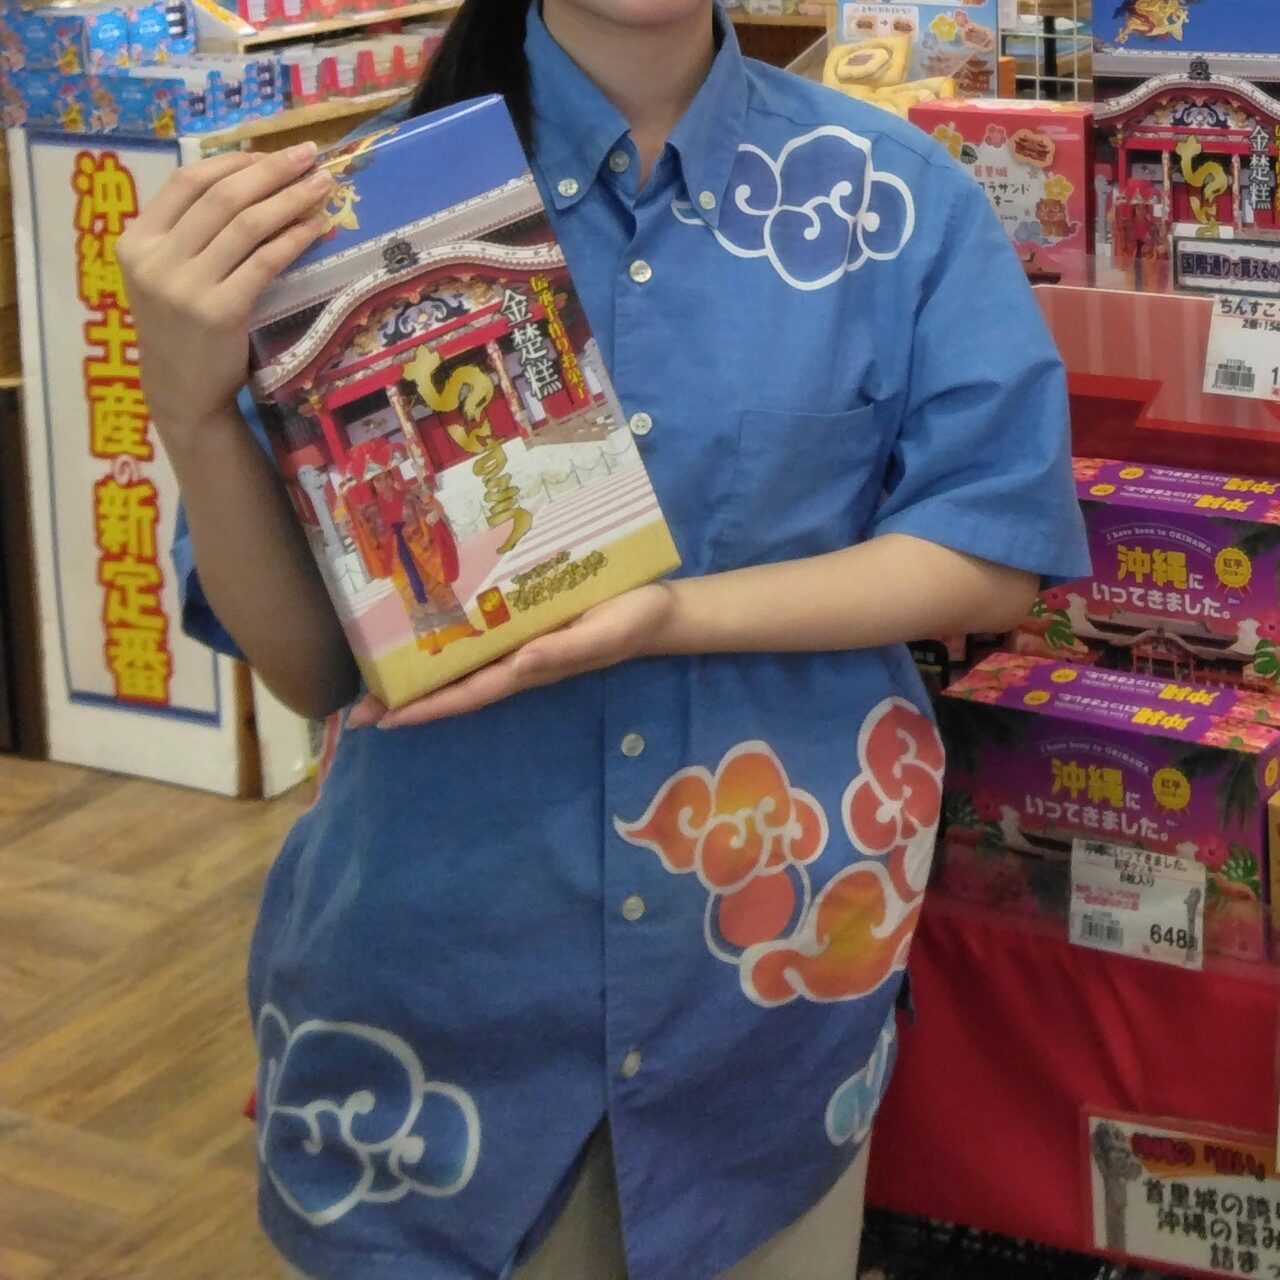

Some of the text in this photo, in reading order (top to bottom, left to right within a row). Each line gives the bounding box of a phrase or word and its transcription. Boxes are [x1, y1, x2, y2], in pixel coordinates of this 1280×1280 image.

[1248, 125, 1273, 210] 金楚糕
[500, 288, 563, 401] 金楚糕
[1117, 544, 1204, 590] 沖縄に
[1223, 558, 1244, 568] 紅芋
[1092, 582, 1231, 619] いってきました。
[1051, 758, 1141, 809] 沖縄に
[1025, 794, 1169, 841] いってきました。
